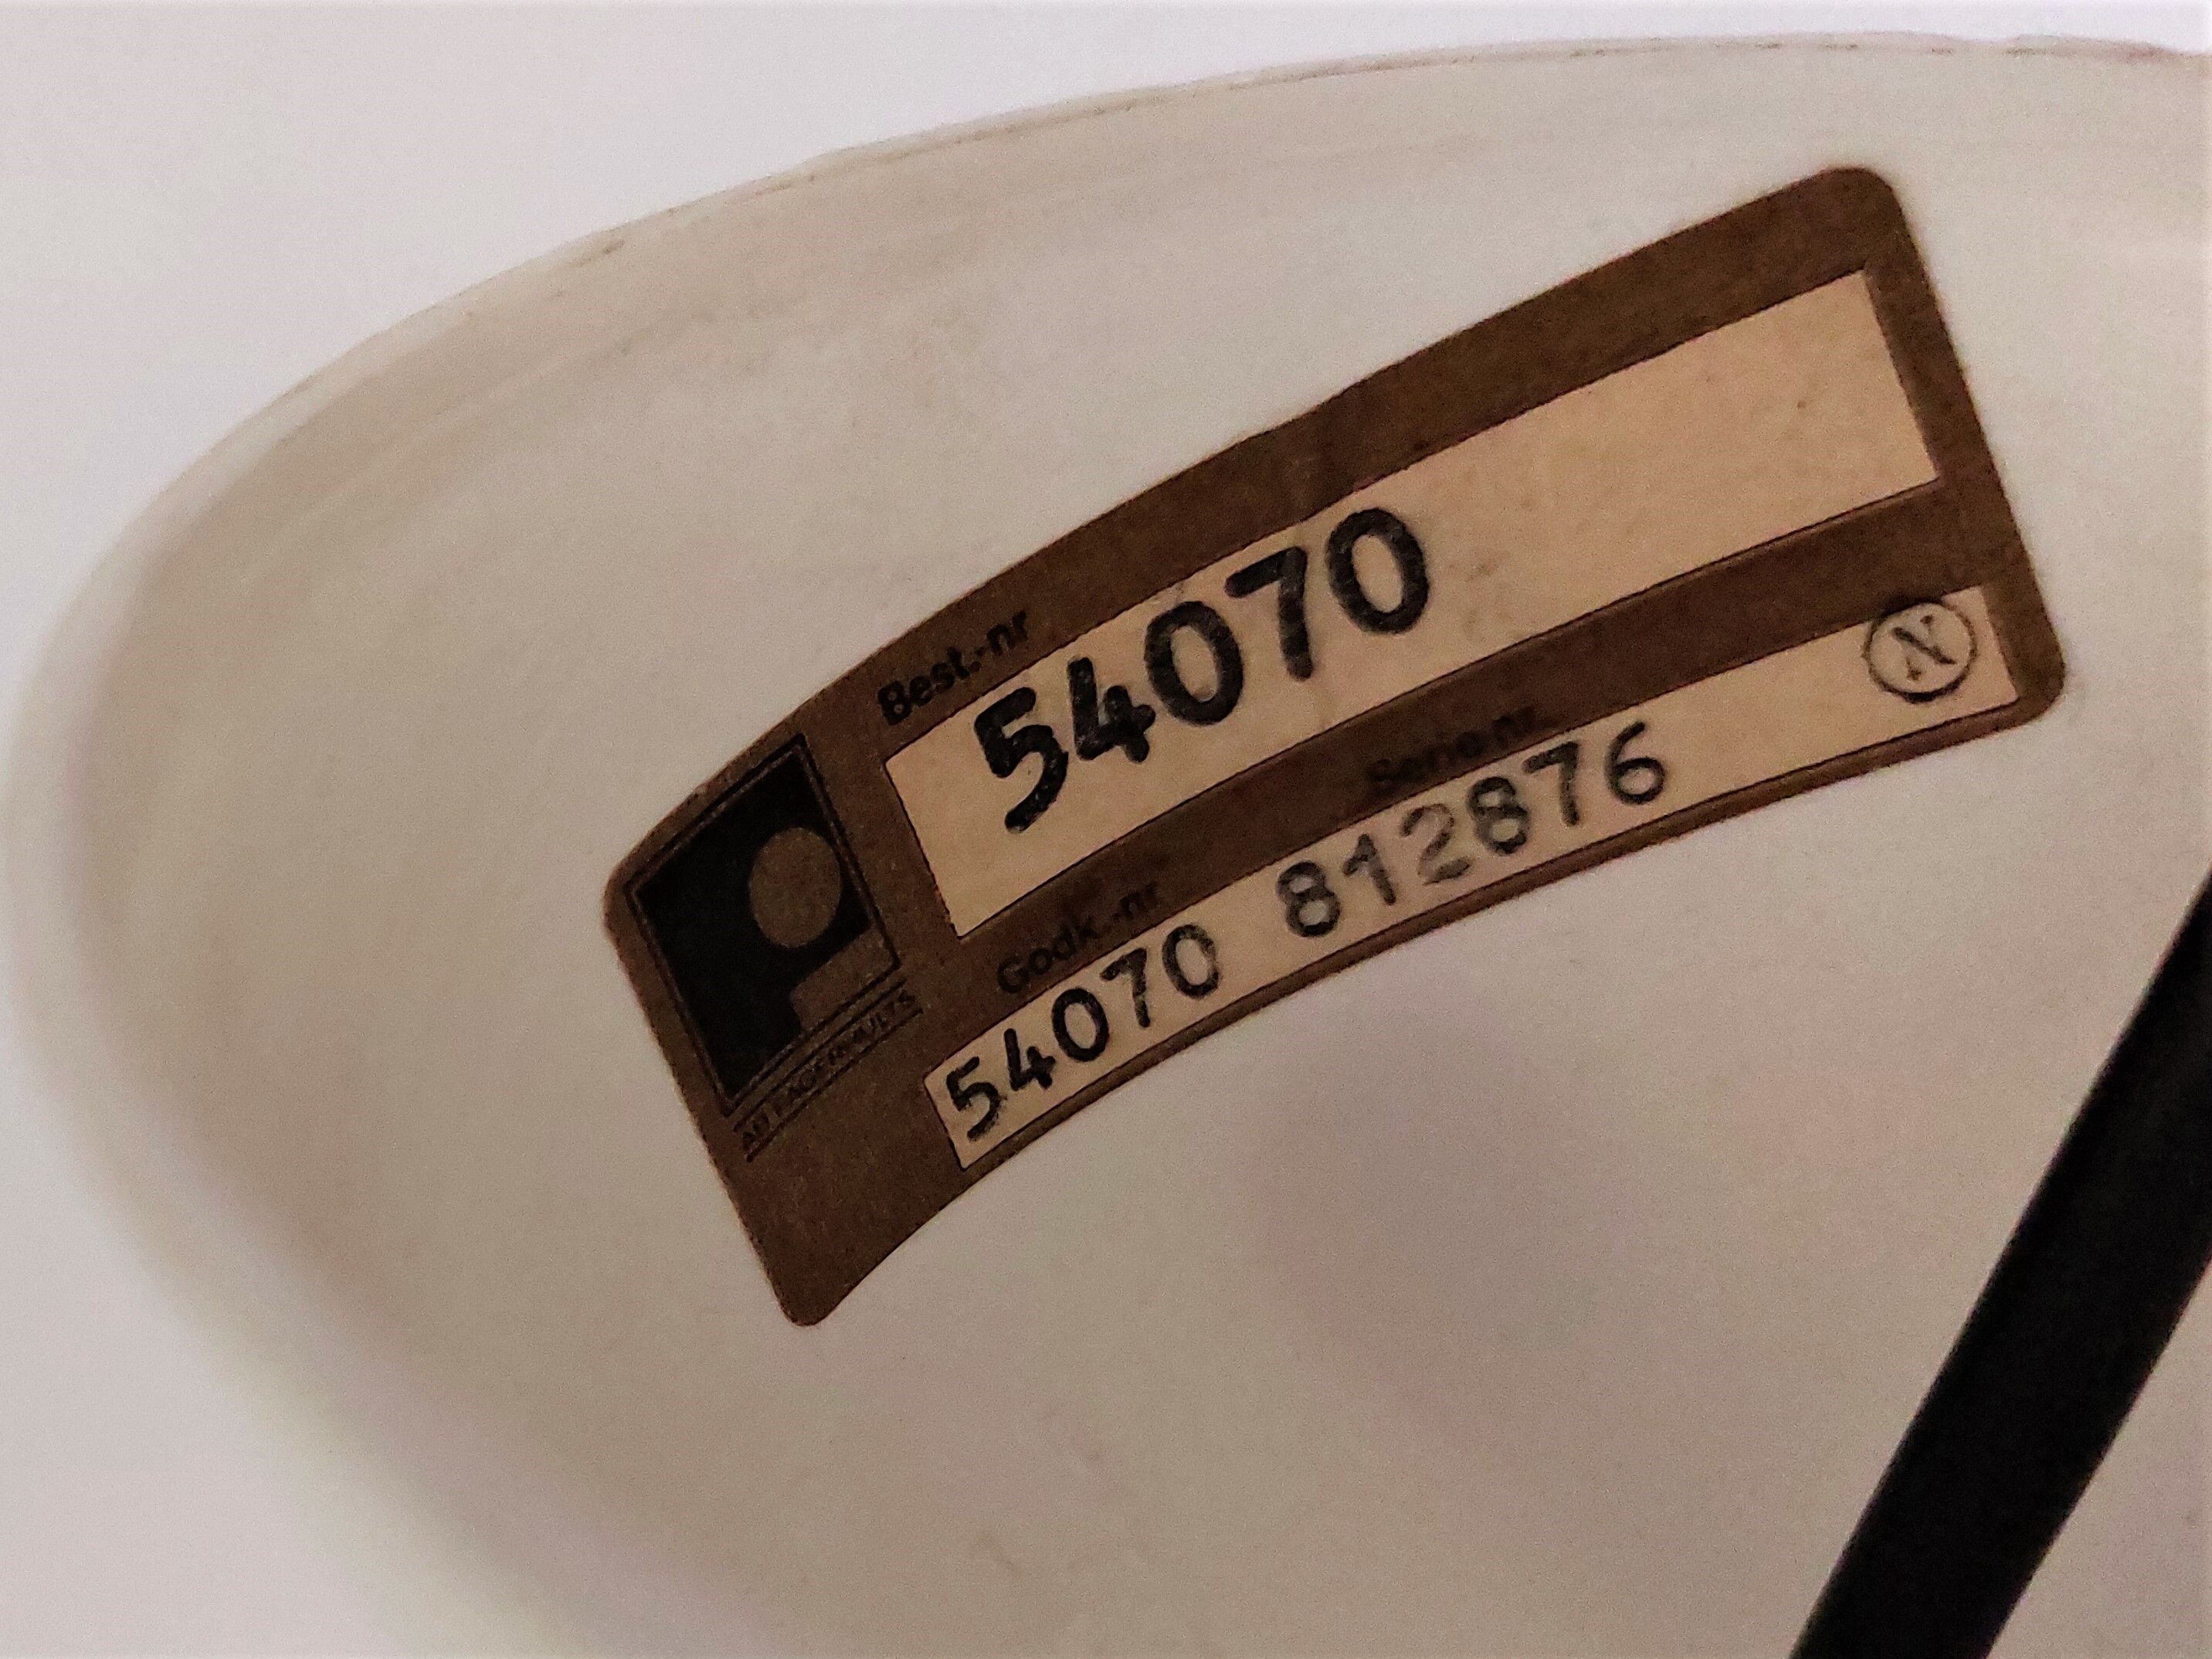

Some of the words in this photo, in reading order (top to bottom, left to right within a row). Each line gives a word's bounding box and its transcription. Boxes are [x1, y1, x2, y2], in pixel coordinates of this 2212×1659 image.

[974, 508, 1430, 833] 54070
[946, 924, 1221, 1141] 54070
[1277, 721, 1666, 938] 812876
